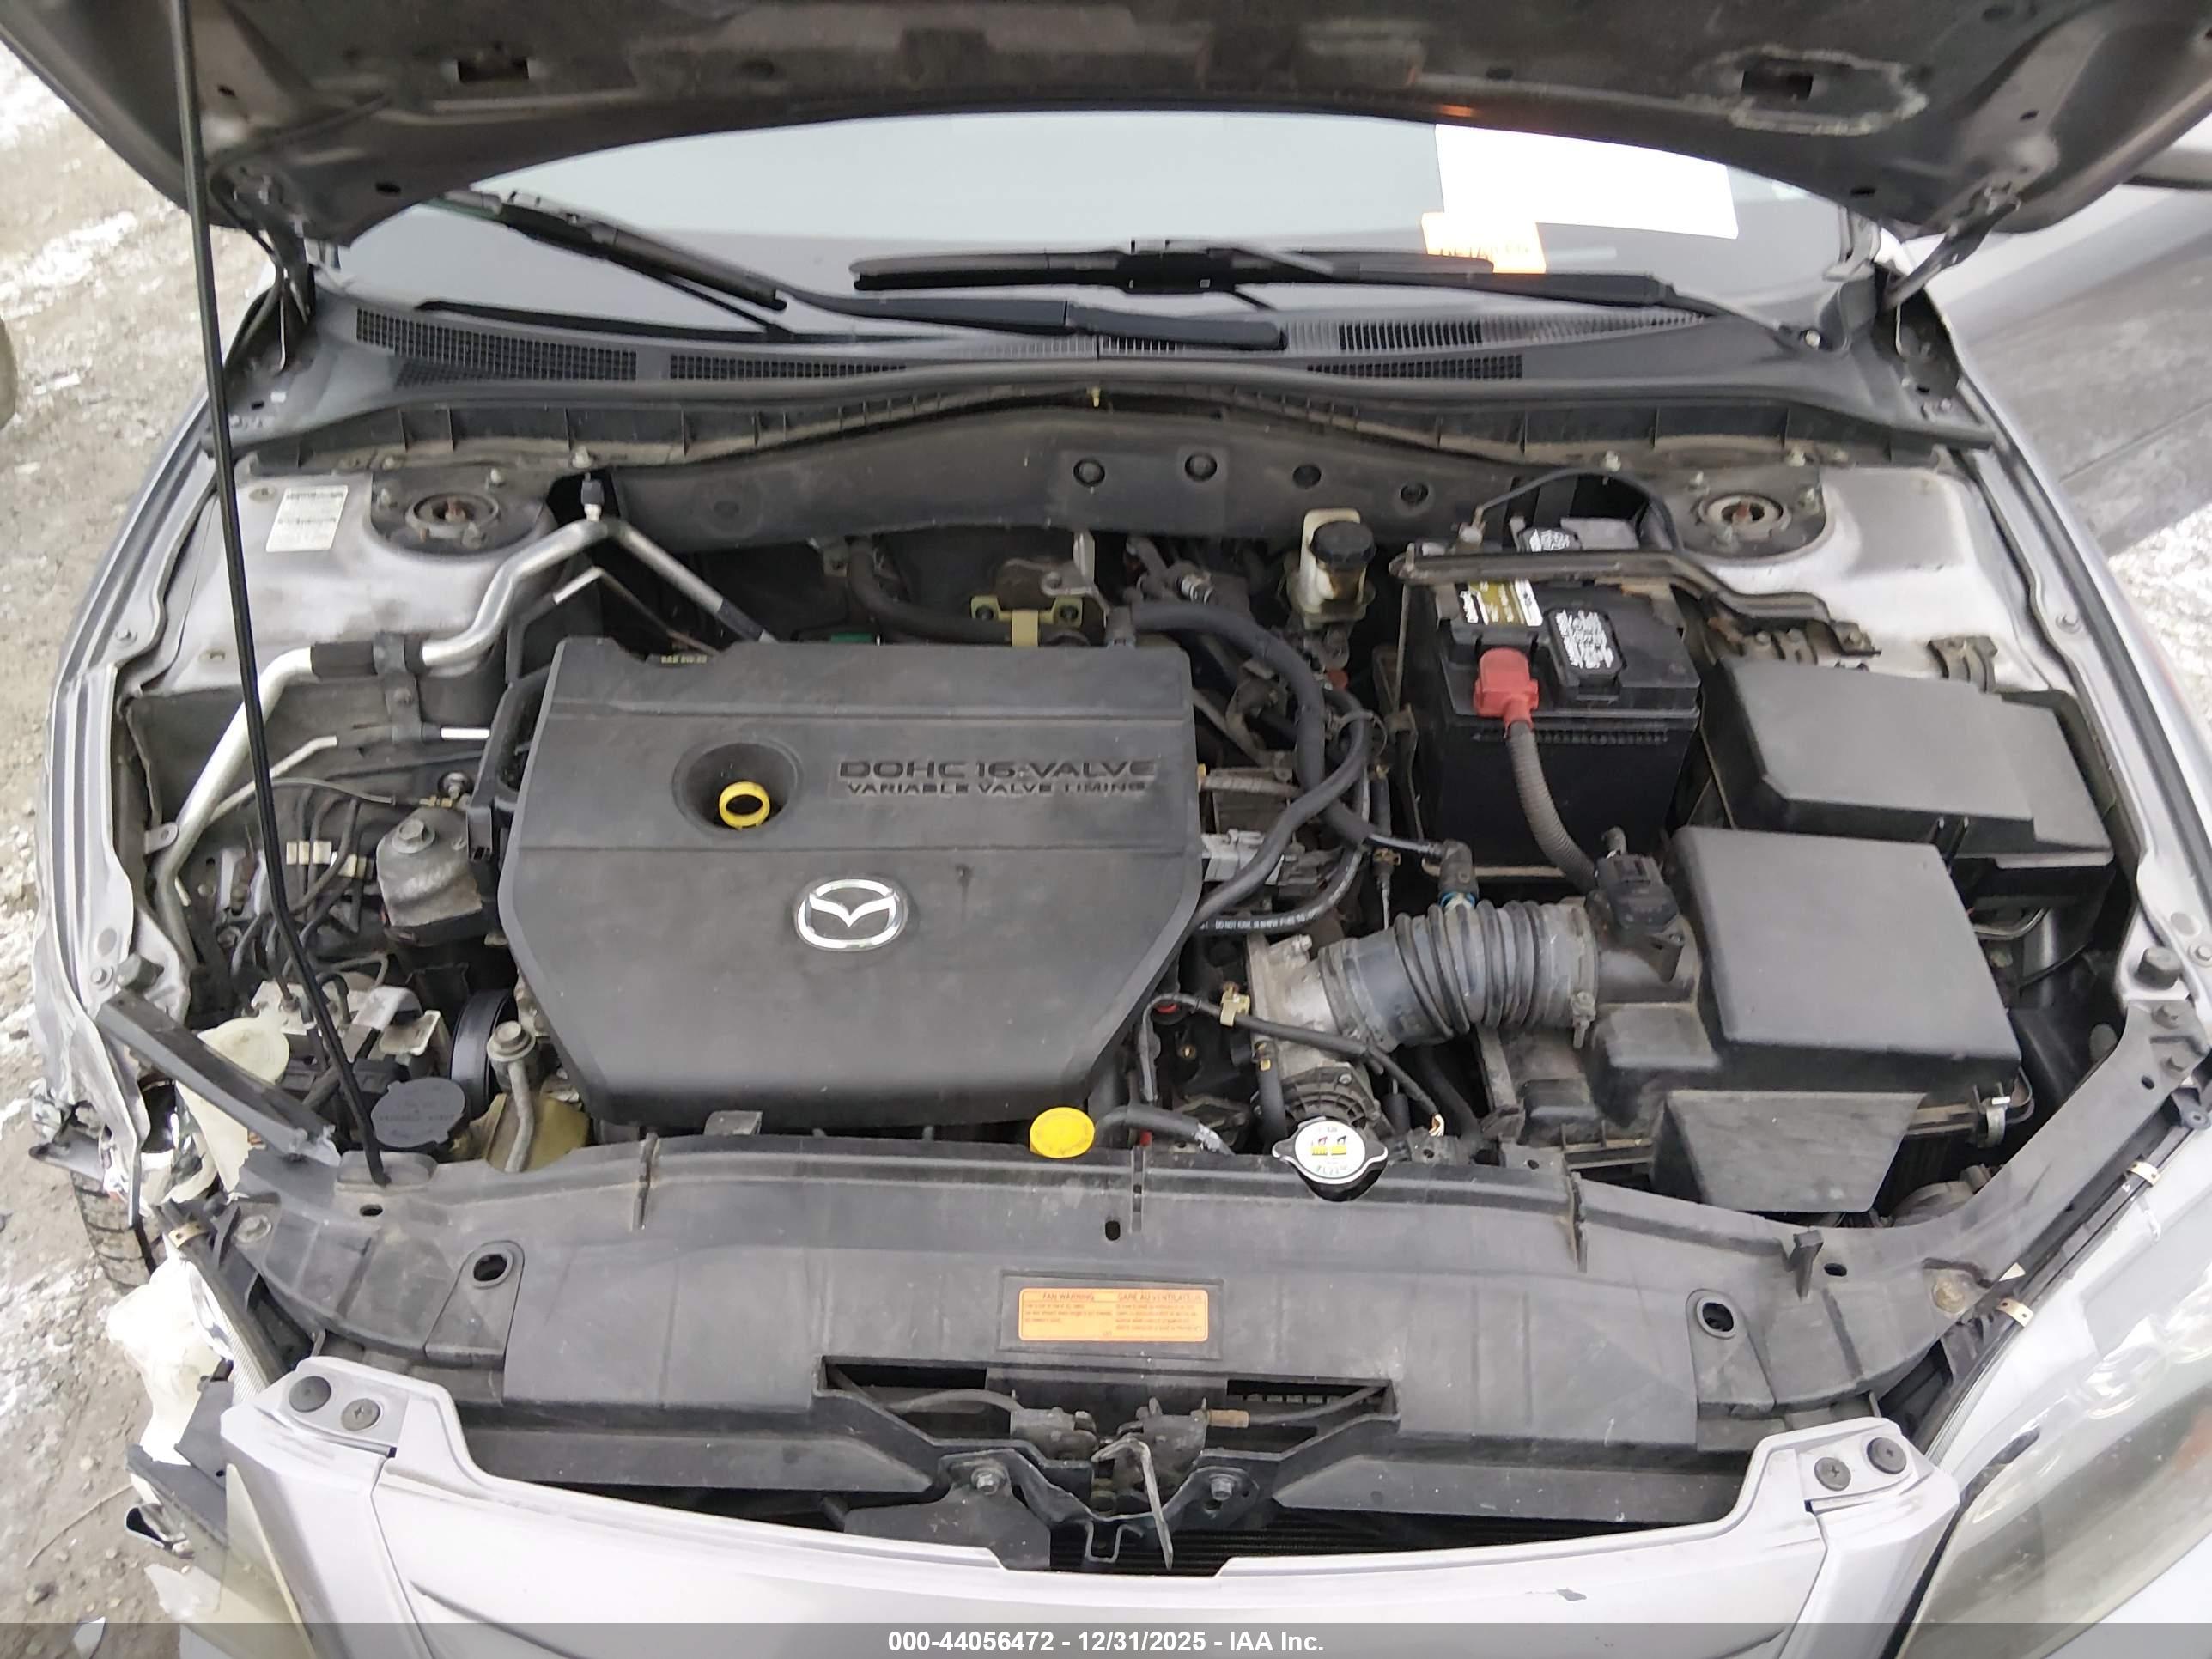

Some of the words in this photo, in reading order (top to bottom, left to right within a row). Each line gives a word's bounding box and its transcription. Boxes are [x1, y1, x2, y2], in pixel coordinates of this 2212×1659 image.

[839, 761, 966, 778] DOHC
[848, 782, 969, 794] VARIABLE
[978, 782, 1052, 793] VALVE
[1064, 781, 1146, 793] TIMING
[1060, 1292, 1094, 1301] WARNING
